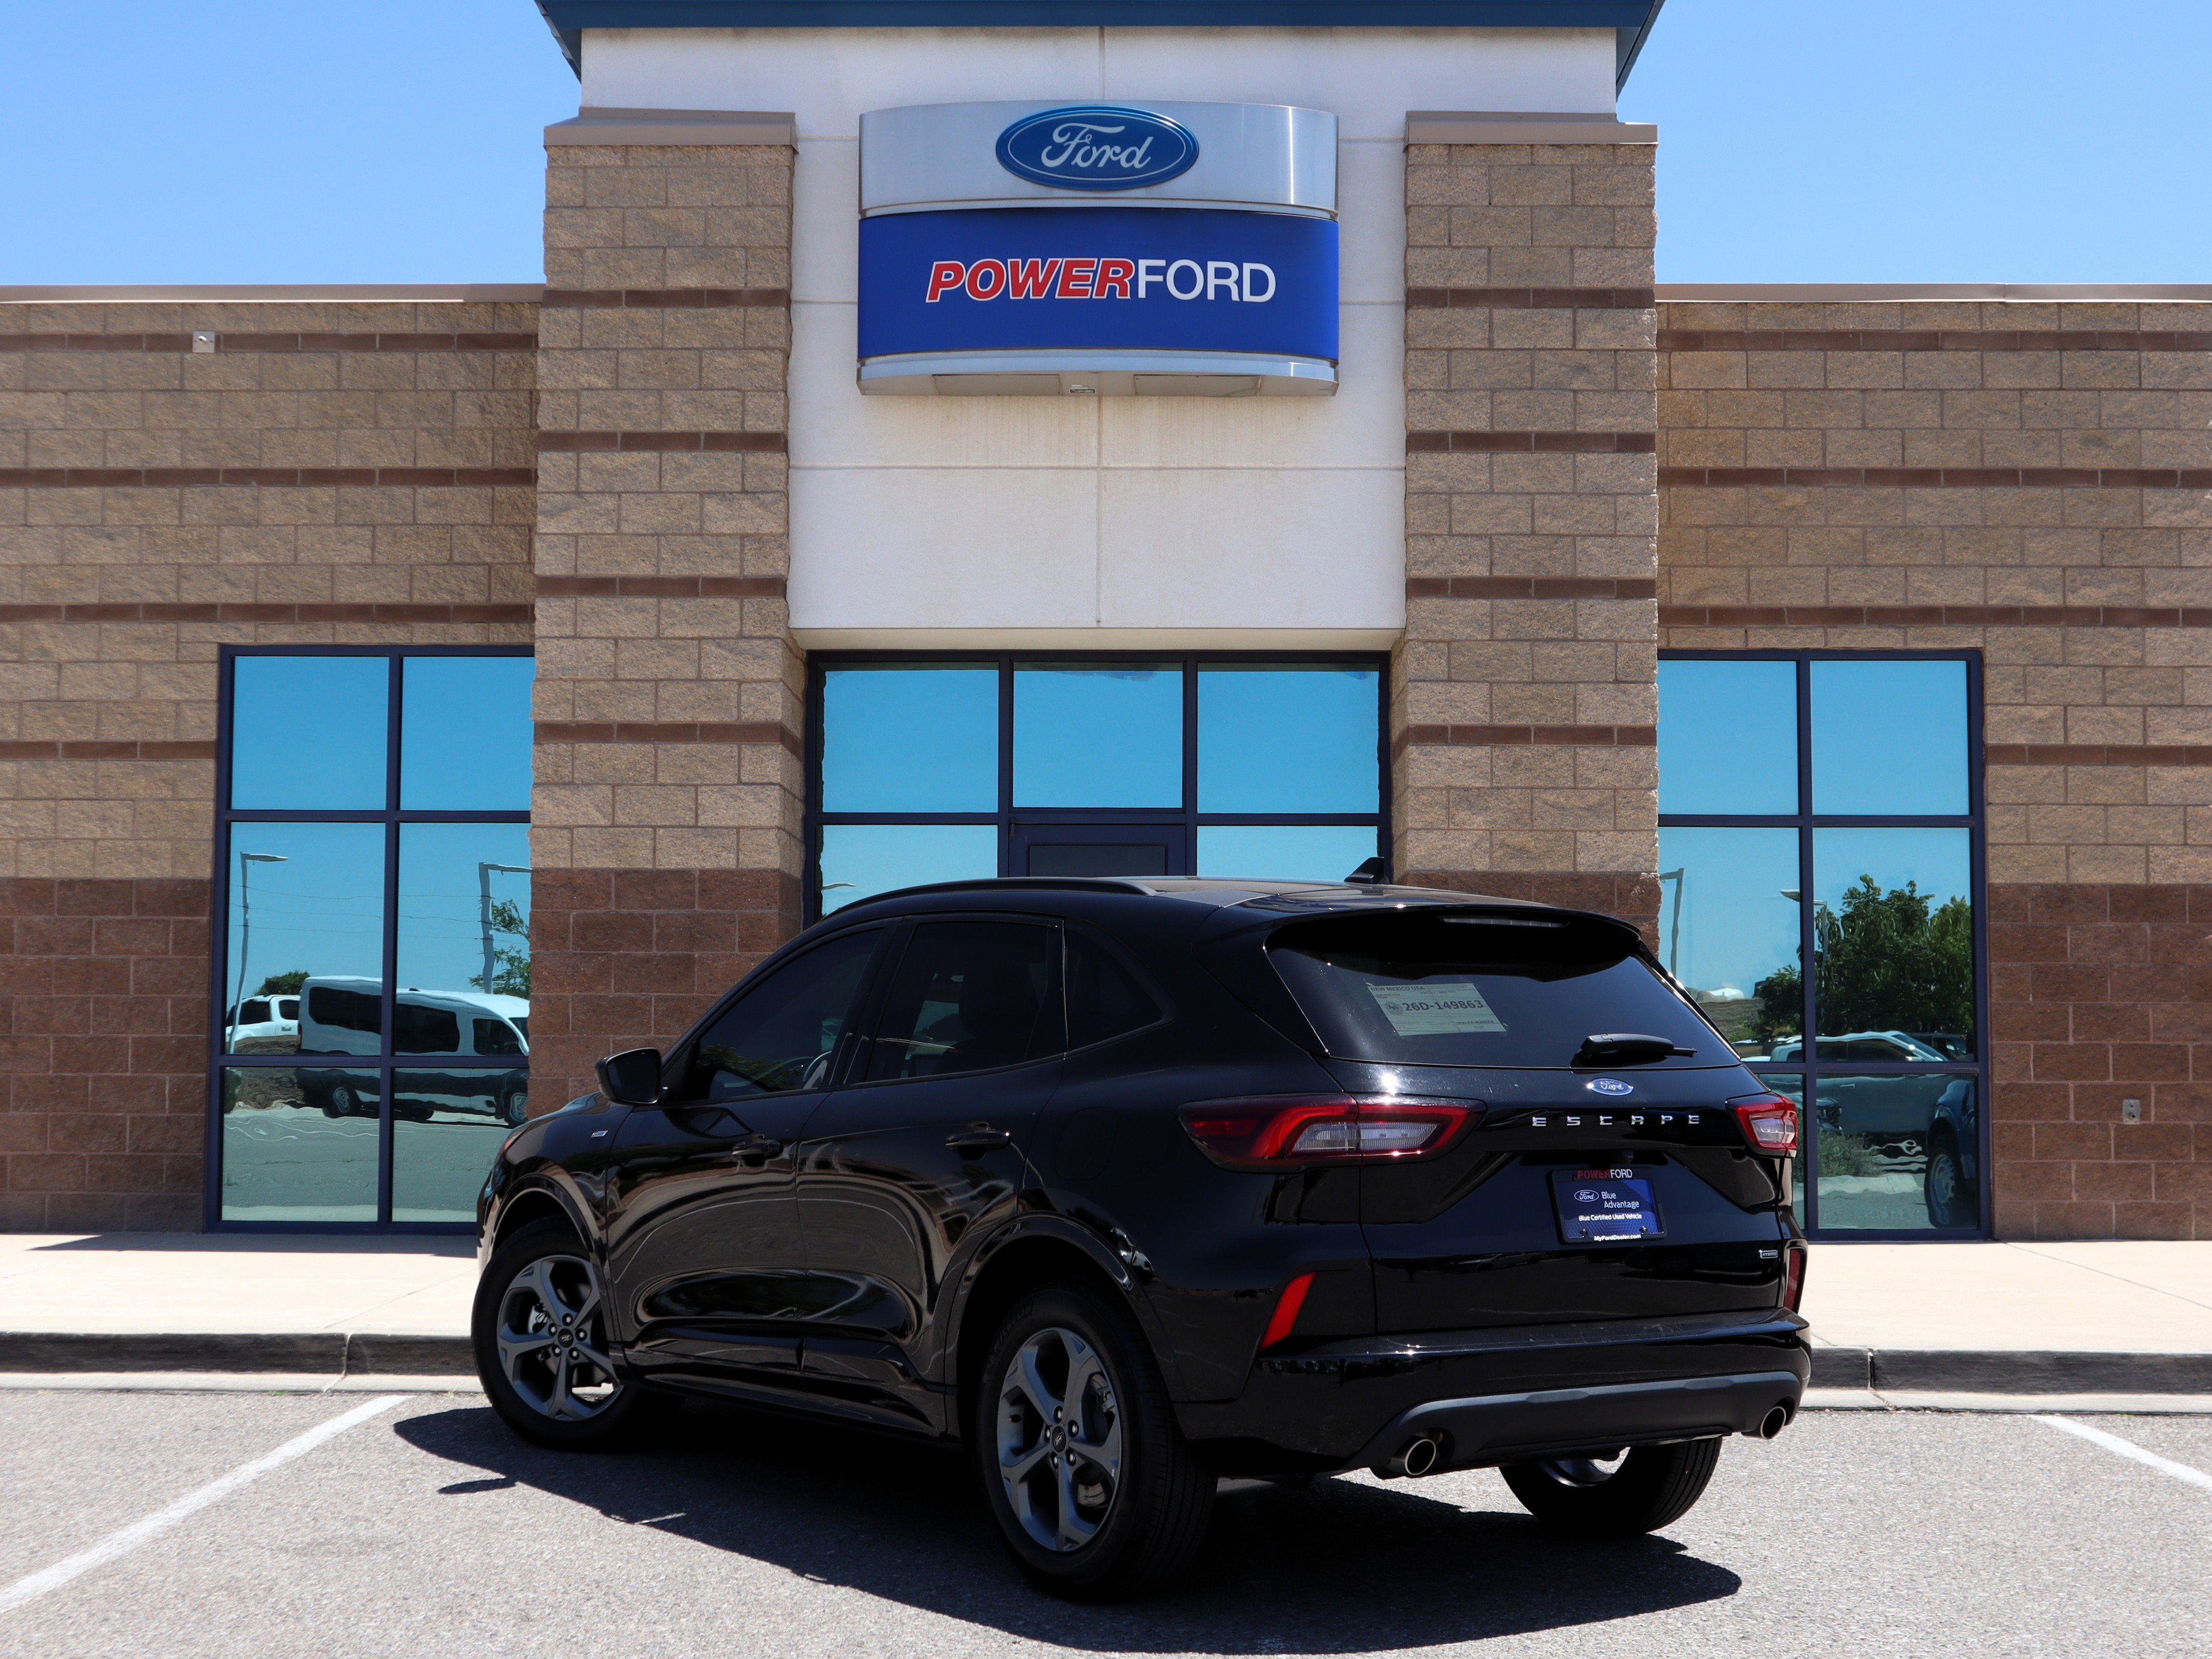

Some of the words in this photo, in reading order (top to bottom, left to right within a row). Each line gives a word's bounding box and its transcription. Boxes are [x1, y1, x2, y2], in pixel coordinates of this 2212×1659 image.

[1040, 123, 1154, 169] Ford
[925, 258, 1276, 303] POWERFORD
[1402, 1000, 1484, 1011] 26D-149863
[1600, 1080, 1624, 1090] Ford
[1532, 1115, 1700, 1127] ESCAPE
[1579, 1191, 1594, 1200] Ford
[1601, 1191, 1617, 1199] Blue
[1604, 1201, 1640, 1209] Advantage
